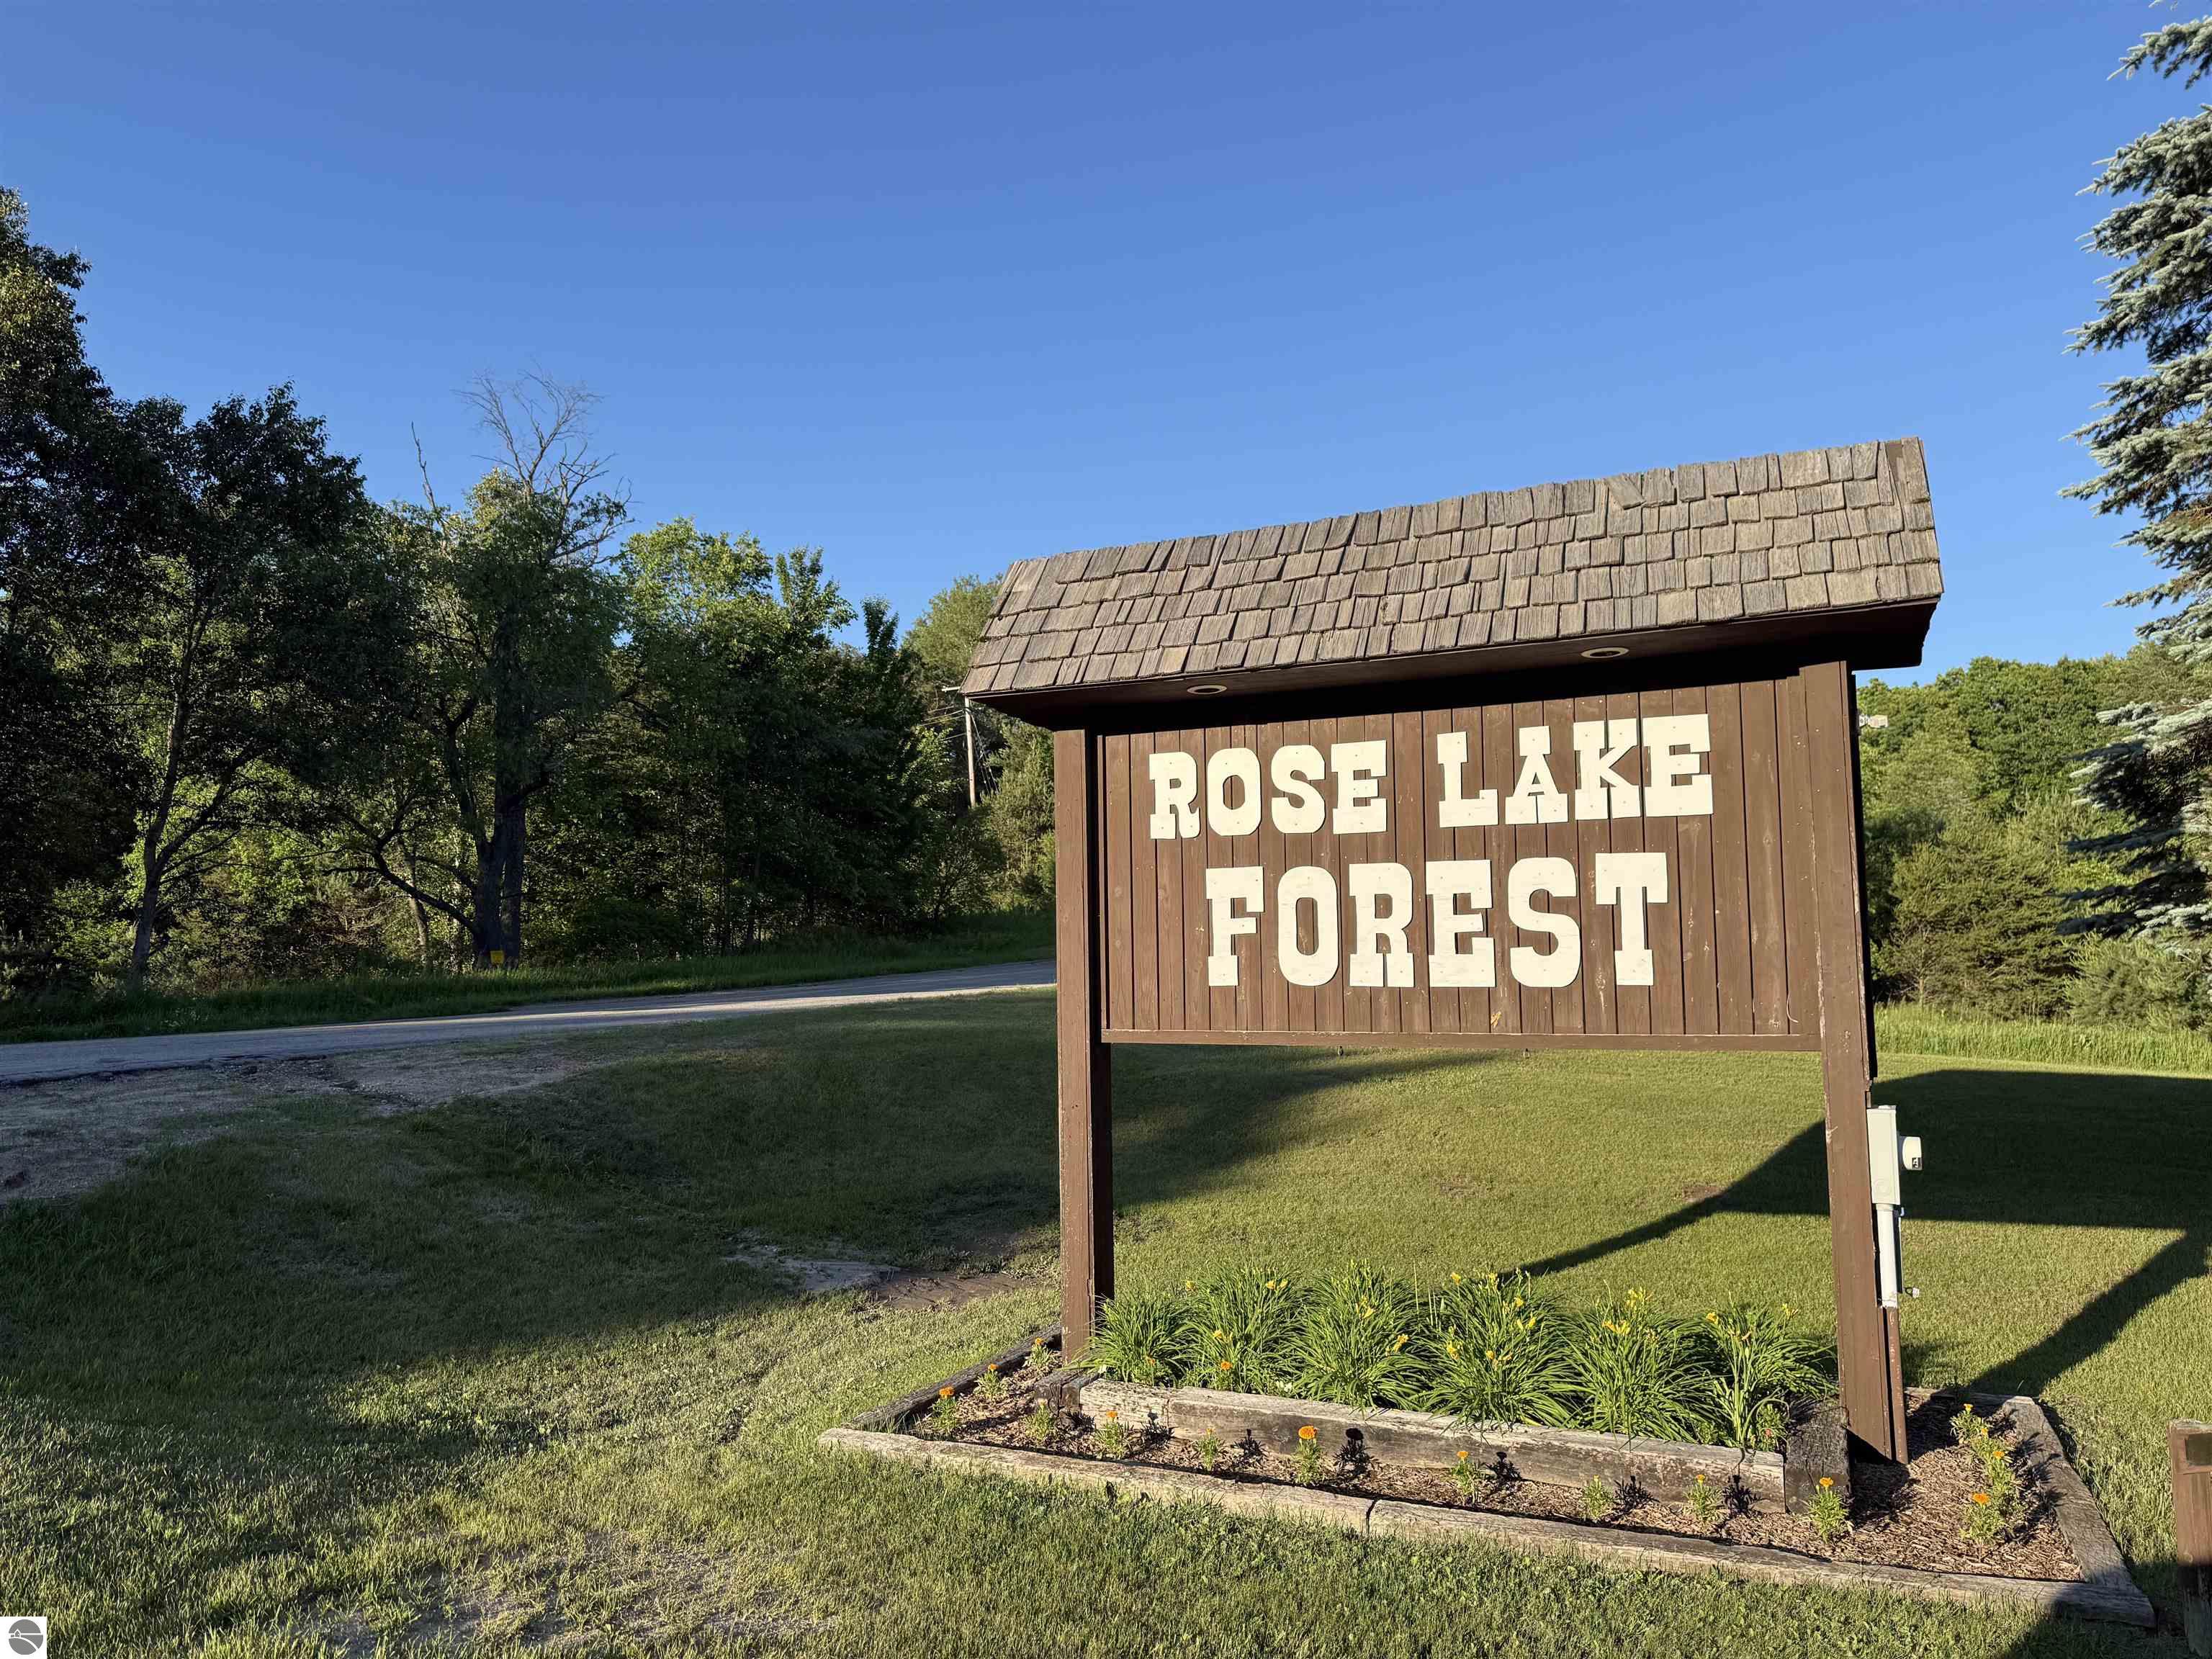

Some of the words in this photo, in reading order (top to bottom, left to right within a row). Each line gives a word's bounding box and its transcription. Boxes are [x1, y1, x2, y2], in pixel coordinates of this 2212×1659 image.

[1148, 739, 1388, 840] ROSE
[1436, 712, 1714, 829] LAKE
[1205, 851, 1668, 989] FOREST
